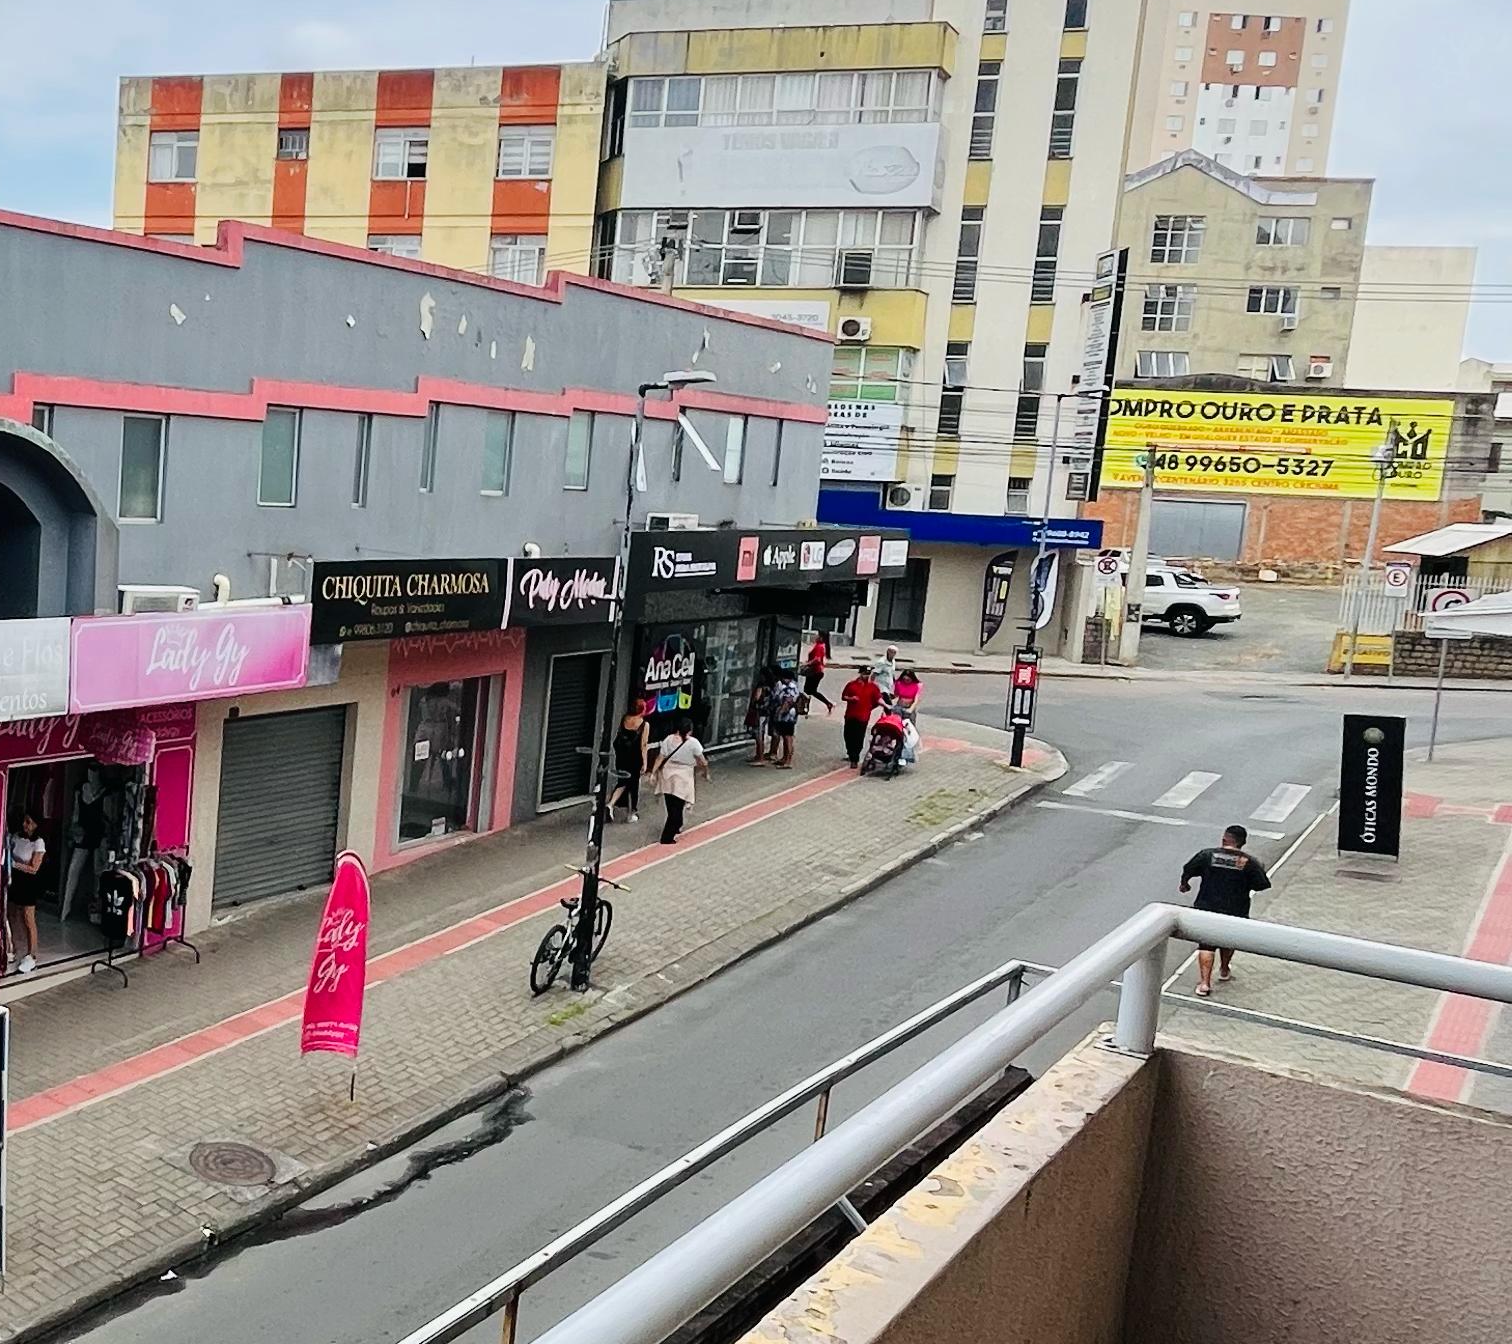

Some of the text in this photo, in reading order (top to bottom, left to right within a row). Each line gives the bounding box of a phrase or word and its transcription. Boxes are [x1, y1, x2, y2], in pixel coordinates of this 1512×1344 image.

[1110, 399, 1383, 426] OMPRO OURO E PRATA
[1155, 454, 1335, 477] 48 99650-5327
[322, 572, 489, 605] CHIQUITA CHARMOSA
[1393, 572, 1401, 583] E
[2, 646, 16, 668] e
[146, 622, 250, 691] Lady Gy
[1359, 747, 1380, 844] ÓTICAS MONDO
